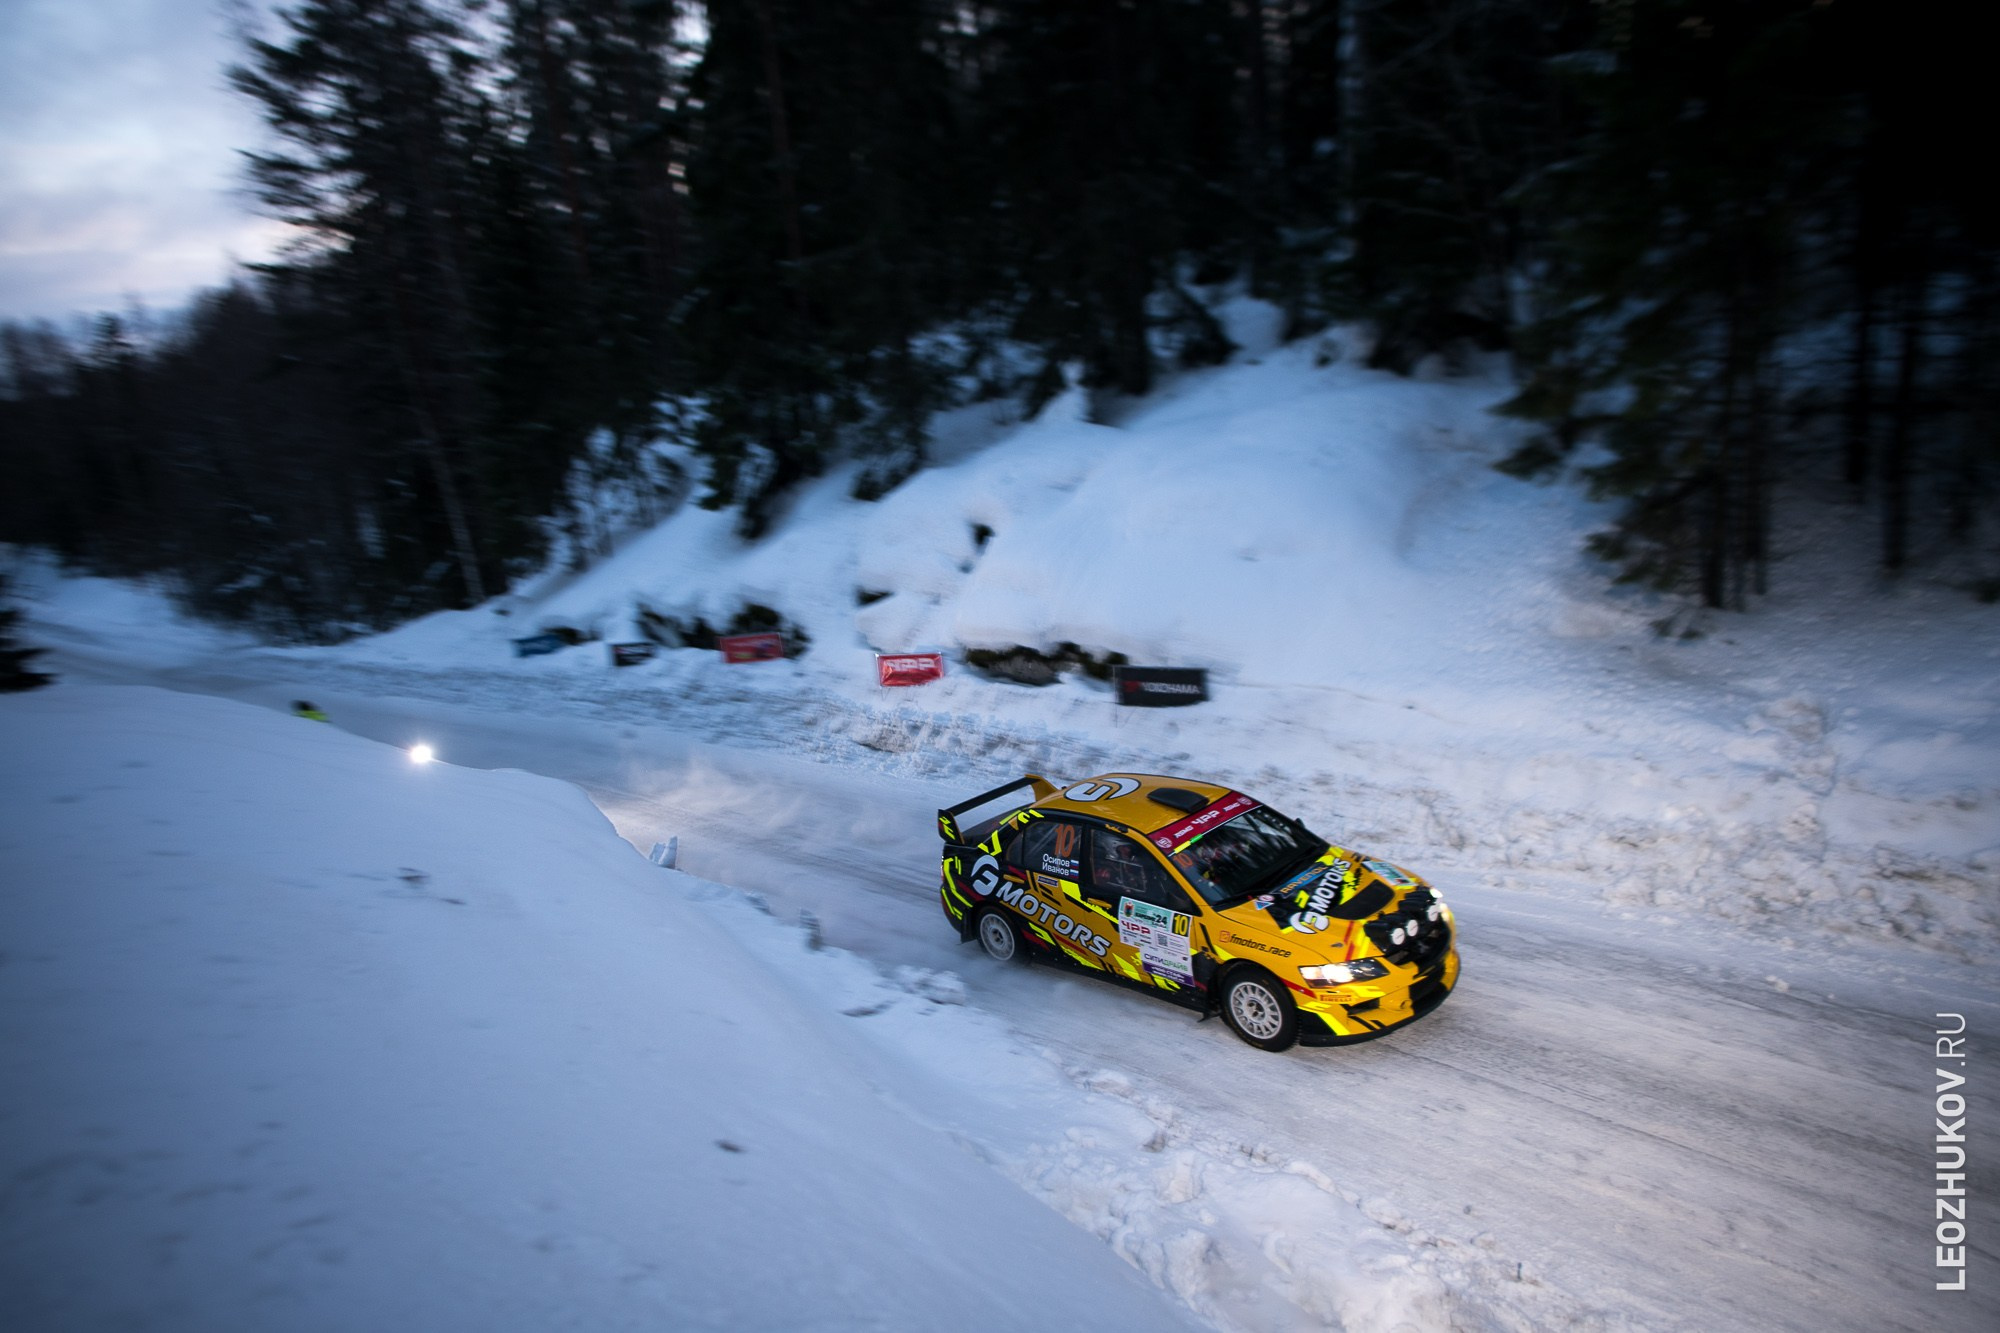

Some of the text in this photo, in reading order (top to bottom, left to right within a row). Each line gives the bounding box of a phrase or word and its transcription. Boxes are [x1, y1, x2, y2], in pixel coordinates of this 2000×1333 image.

[1142, 682, 1201, 694] YOKOHAMA
[1191, 810, 1220, 824] ЧРР
[1055, 824, 1075, 858] 10
[1042, 862, 1070, 876] Иванов
[1043, 853, 1070, 867] Осипов
[1280, 866, 1328, 894] RAVENOL
[996, 881, 1111, 957] MOTORS
[1121, 920, 1151, 935] ЧРР
[1174, 914, 1189, 936] 10
[1230, 934, 1292, 958] fmotors_race
